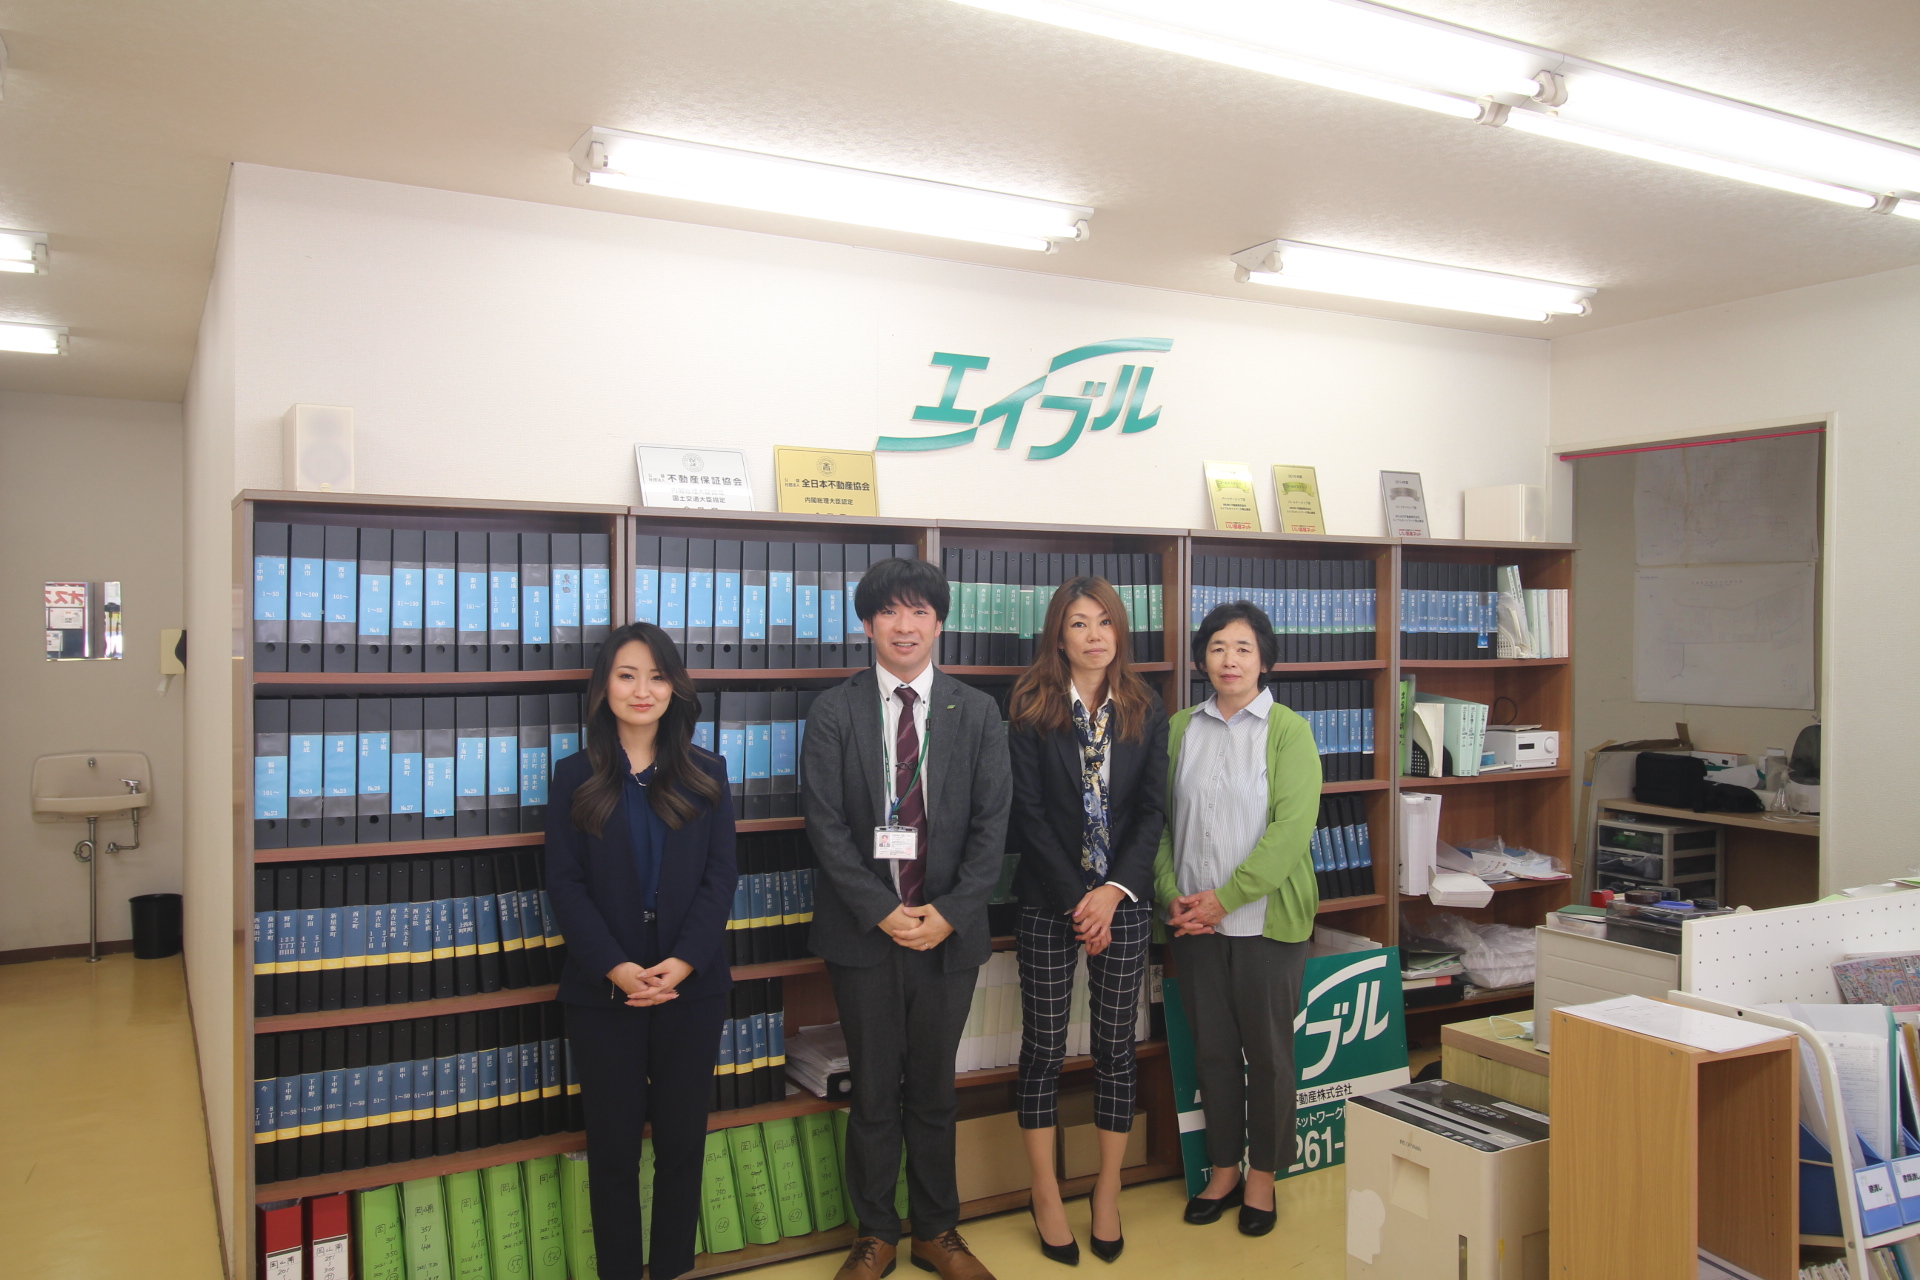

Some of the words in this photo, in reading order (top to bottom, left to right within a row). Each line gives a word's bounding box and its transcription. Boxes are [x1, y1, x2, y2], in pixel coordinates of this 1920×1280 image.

[873, 337, 1174, 460] エイブル
[667, 474, 742, 486] 不動産保証協会
[802, 479, 870, 491] 全日本不動産協会
[805, 497, 853, 505] 内閣総理大臣認定
[278, 563, 285, 576] 西市
[304, 563, 311, 576] 西市
[338, 567, 345, 578] 西市
[372, 580, 379, 592] 新保
[405, 574, 412, 586] 新保
[438, 574, 444, 586] 新保
[470, 578, 476, 589] 新保
[493, 577, 499, 588] 豊成
[511, 577, 517, 588] 豊成
[534, 591, 540, 603] 豊成
[380, 738, 387, 750] 平福
[736, 734, 742, 745] 内尾
[303, 740, 310, 753] 福成
[500, 741, 507, 754] 福島
[268, 762, 275, 774] 福田
[403, 907, 409, 919] 大元
[284, 916, 291, 928] 野田
[307, 914, 314, 927] 野田
[444, 1063, 450, 1074] 田中
[459, 1059, 465, 1070] 今村
[377, 1070, 384, 1083] 平田
[399, 1067, 406, 1079] 田中
[422, 1065, 428, 1077] 田中
[354, 1073, 361, 1086] 平田
